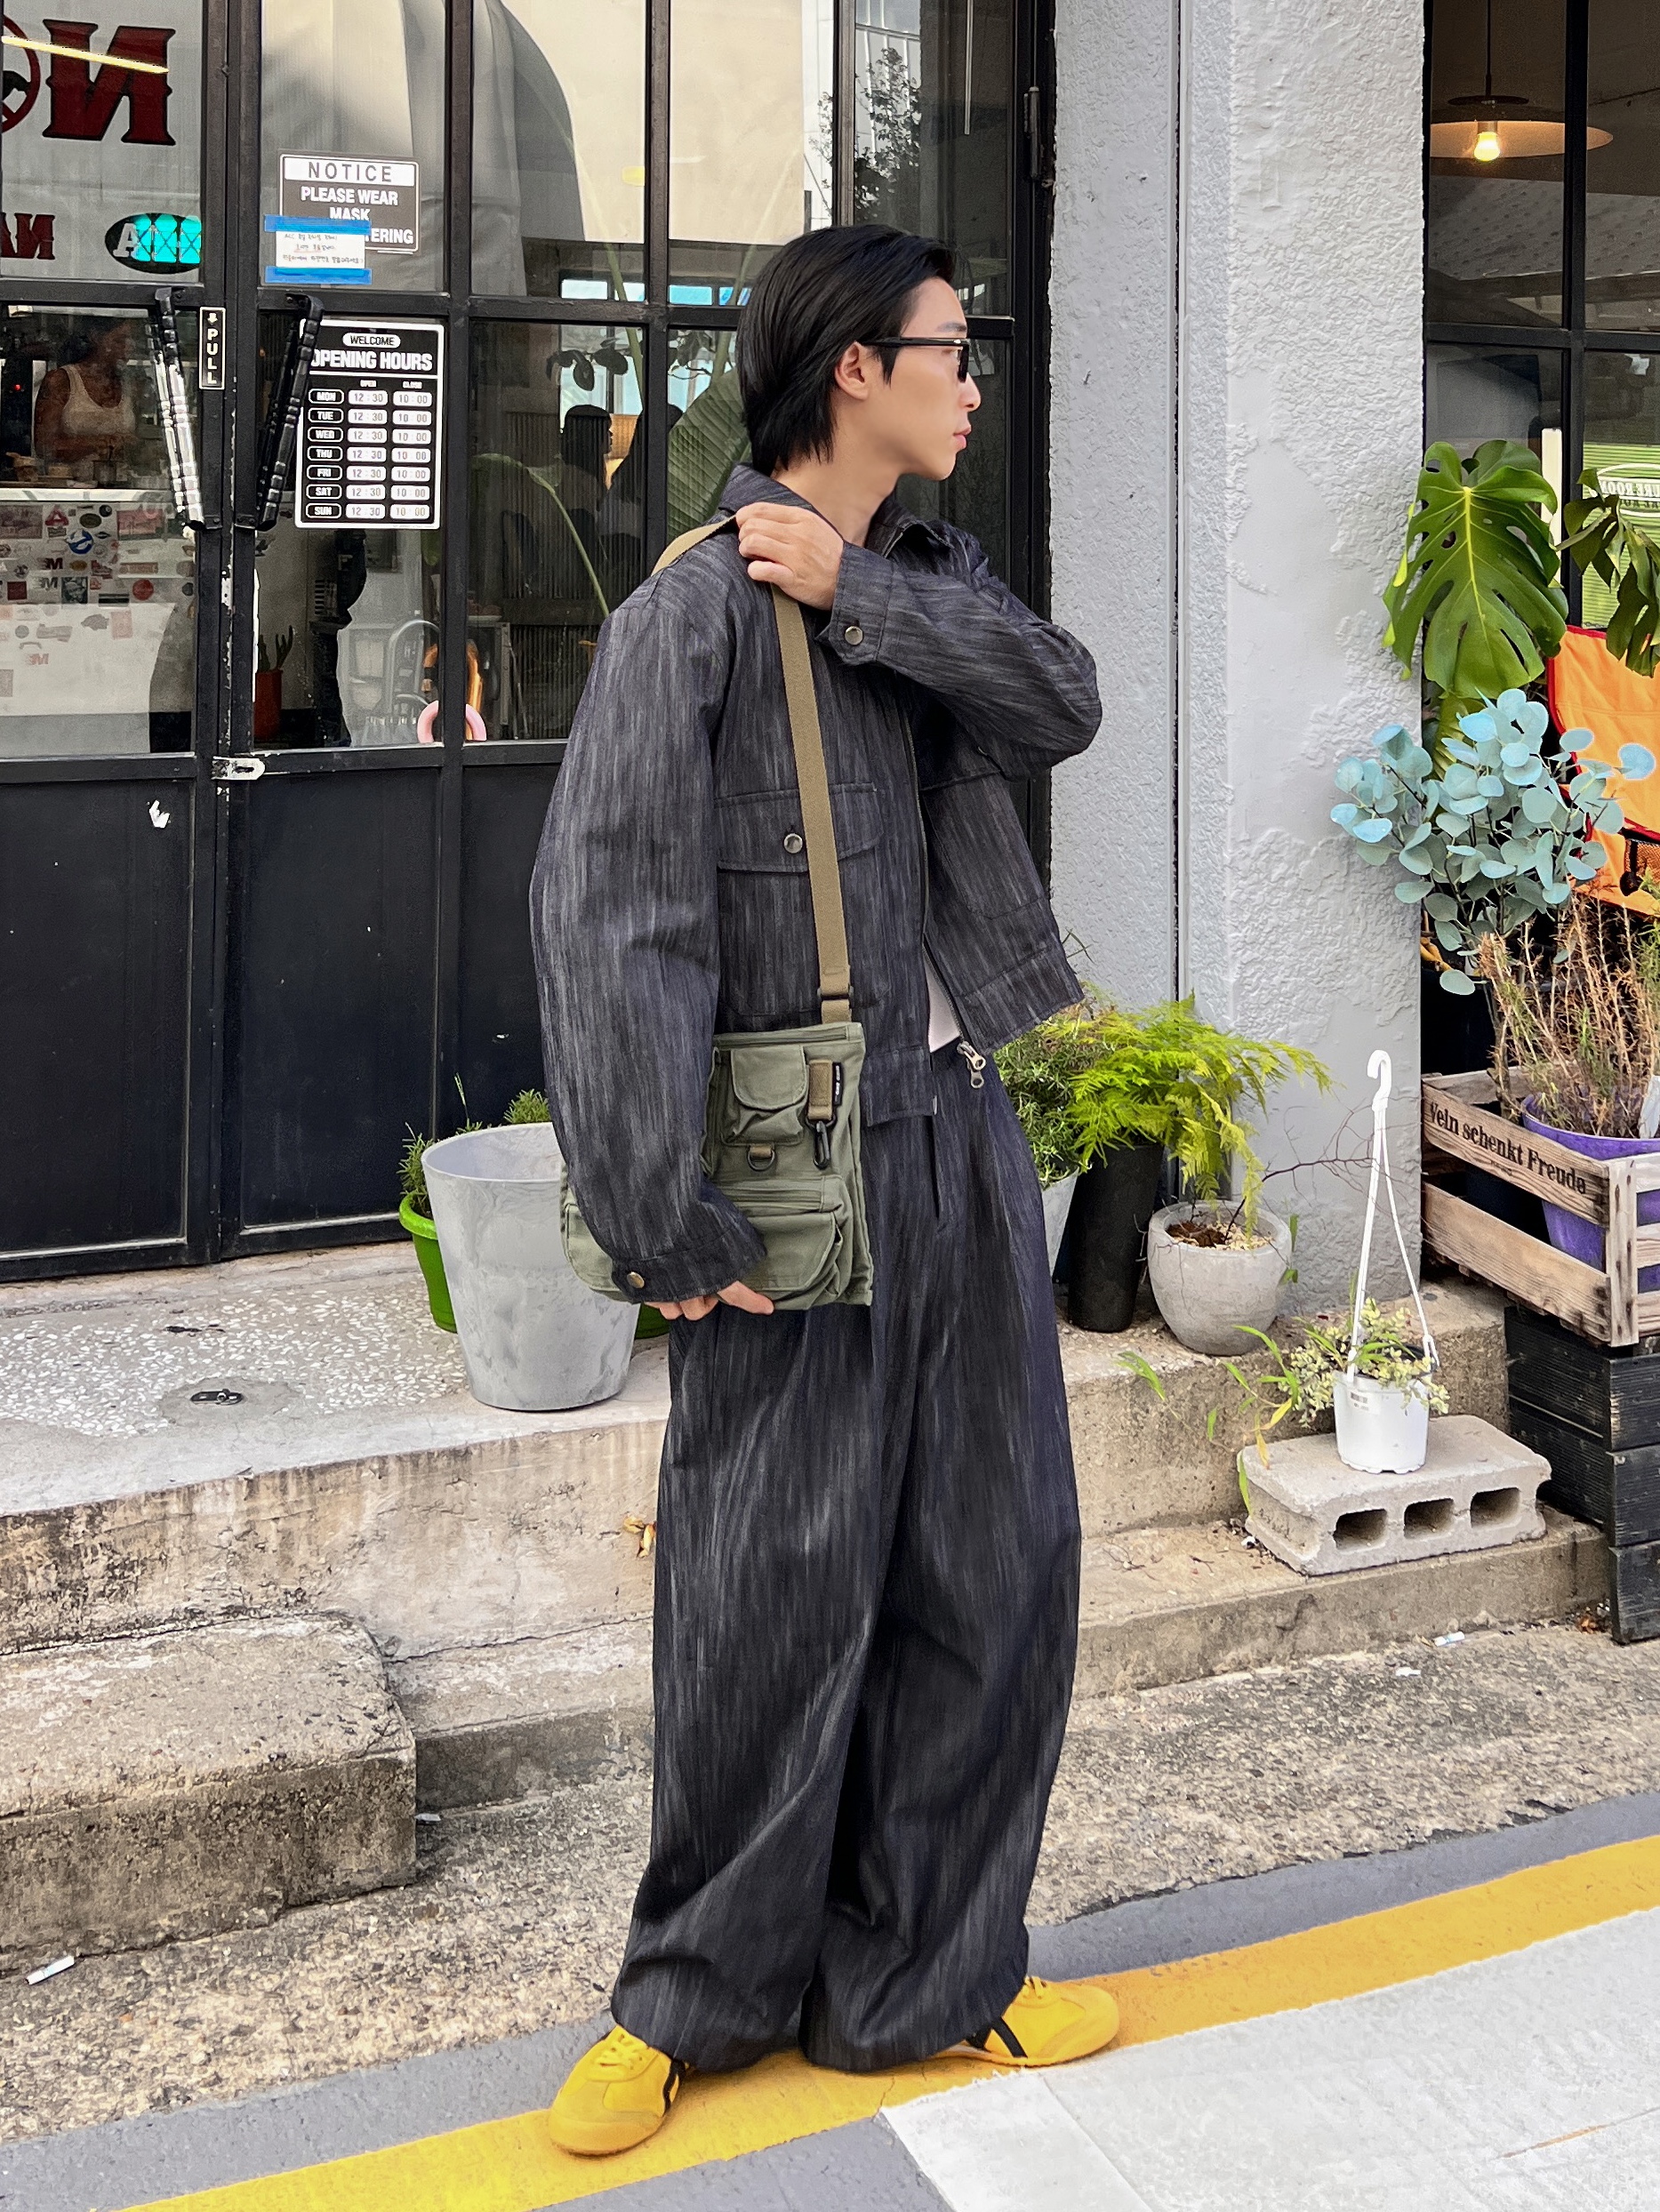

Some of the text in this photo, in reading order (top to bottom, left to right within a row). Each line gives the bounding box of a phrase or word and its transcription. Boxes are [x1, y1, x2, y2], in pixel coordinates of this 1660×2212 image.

[309, 161, 392, 182] NOTICE
[301, 186, 398, 206] PLEASE WEAR
[329, 206, 371, 221] MASK
[350, 335, 395, 346] WELCOME
[206, 327, 219, 384] PULL
[311, 349, 433, 371] OPENING HOURS
[317, 391, 336, 402] MON
[317, 411, 334, 421] TUE
[315, 429, 335, 439] WED
[316, 449, 333, 459] THU
[317, 468, 332, 477] FRI
[315, 486, 333, 497] SAT
[314, 506, 333, 516] SUN
[1463, 1123, 1523, 1166] schenkt
[1527, 1147, 1586, 1194] Freude
